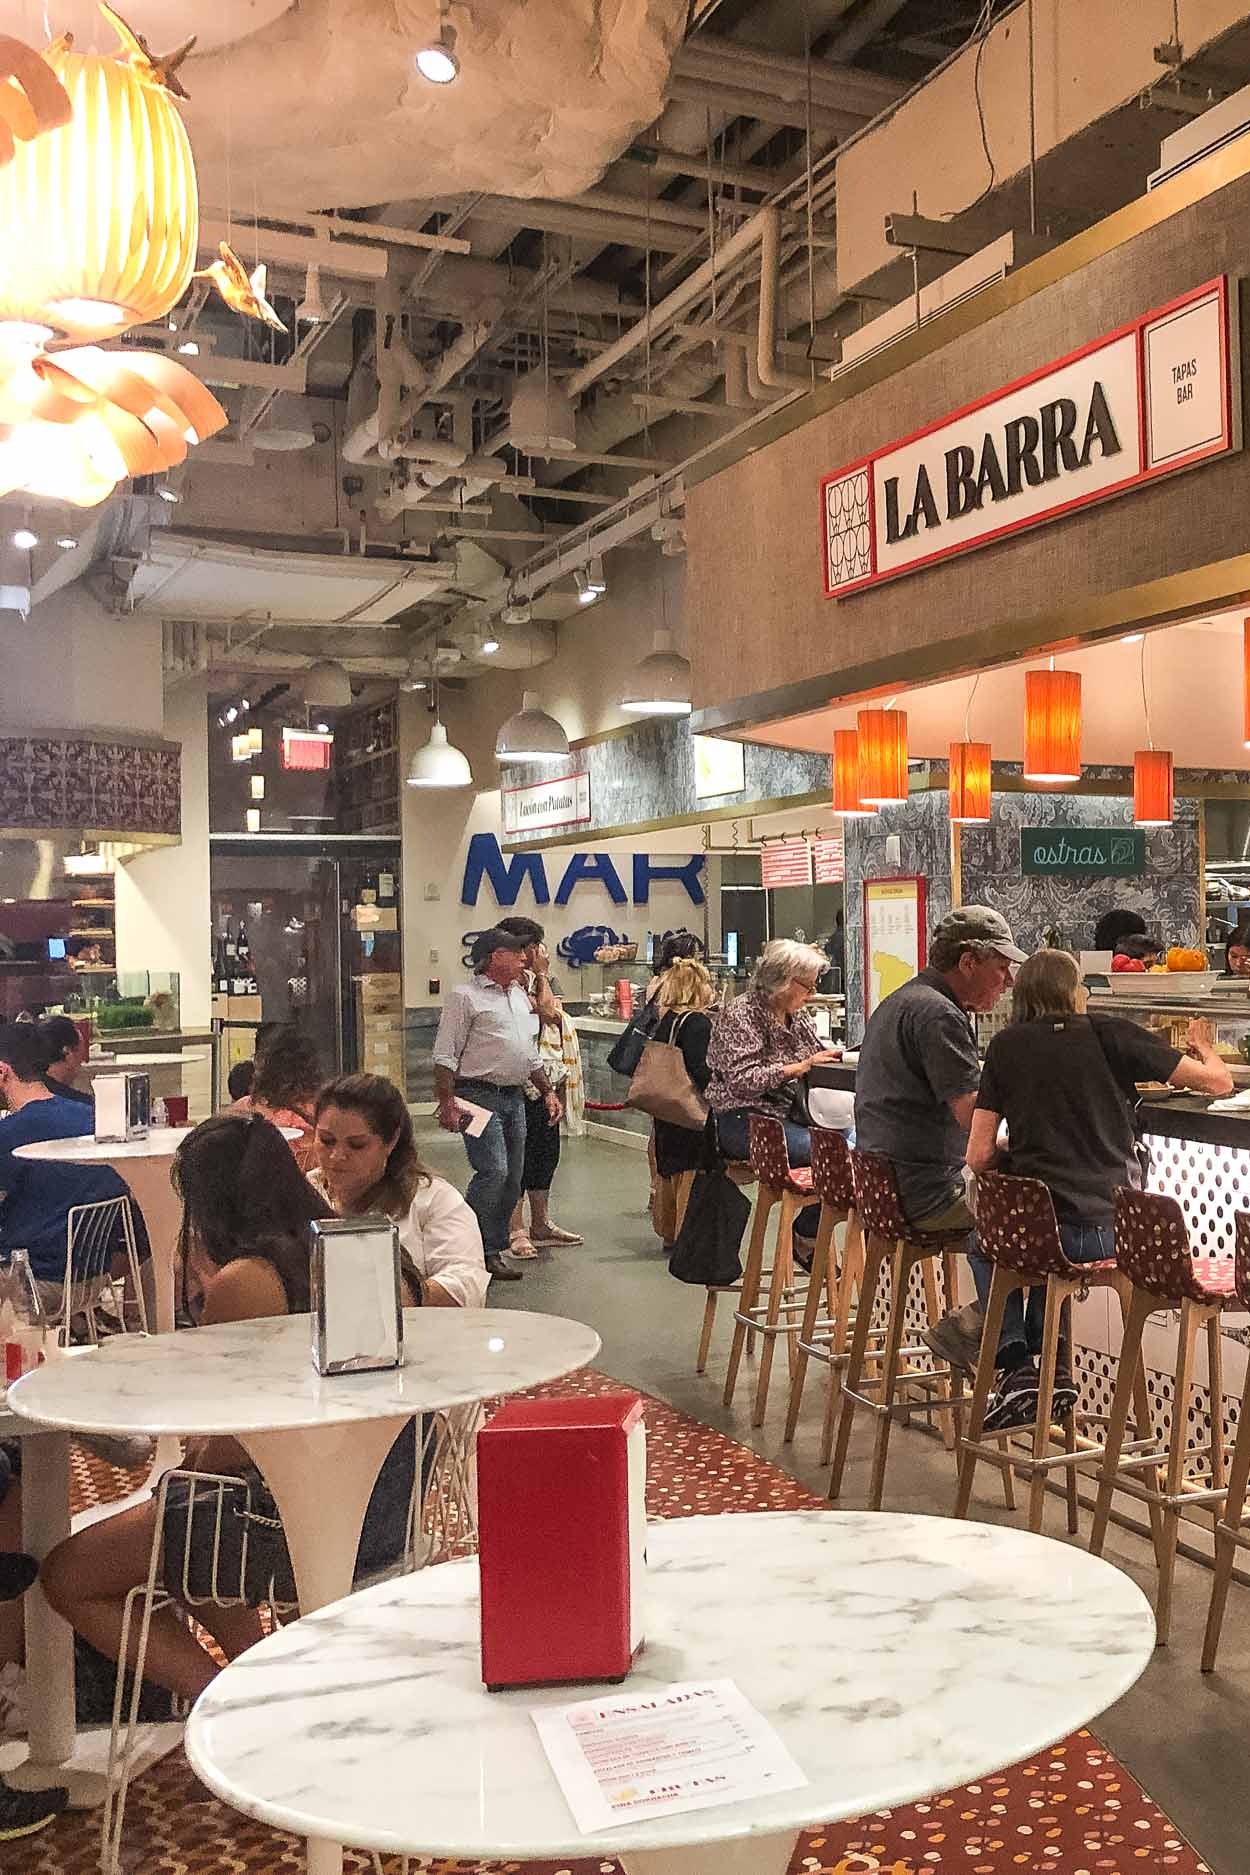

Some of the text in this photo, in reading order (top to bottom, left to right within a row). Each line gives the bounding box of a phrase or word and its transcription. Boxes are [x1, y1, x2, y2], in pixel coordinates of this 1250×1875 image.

[1171, 358, 1197, 385] TAPAS
[1176, 383, 1193, 405] BAR
[884, 381, 1122, 545] LA BARRA
[1033, 836, 1107, 865] ostras
[460, 832, 706, 906] MAR
